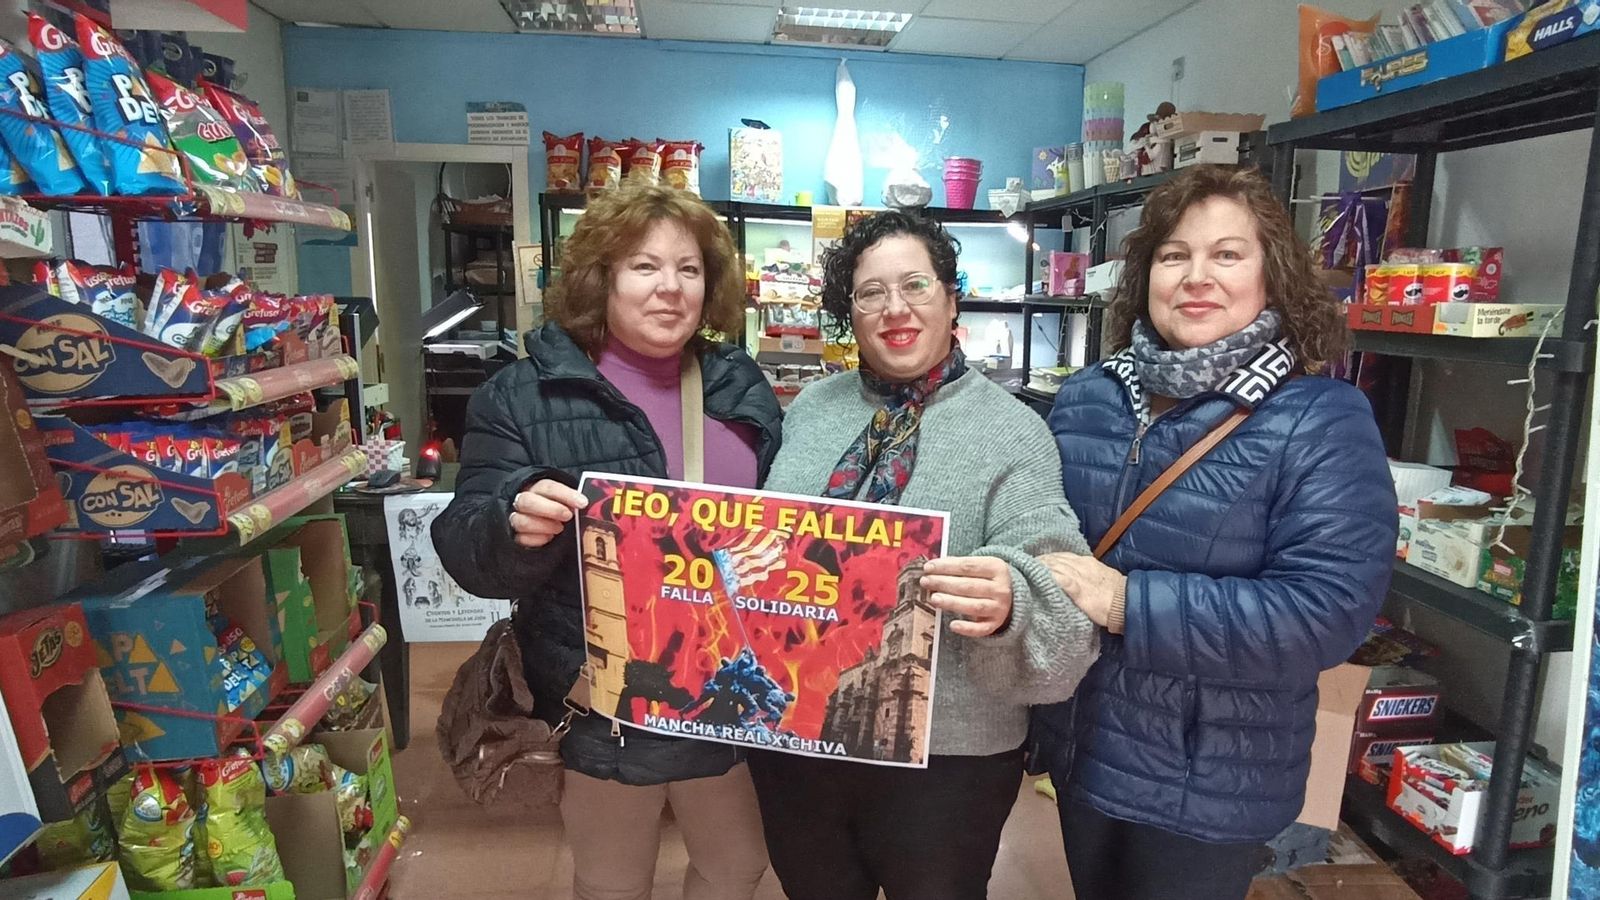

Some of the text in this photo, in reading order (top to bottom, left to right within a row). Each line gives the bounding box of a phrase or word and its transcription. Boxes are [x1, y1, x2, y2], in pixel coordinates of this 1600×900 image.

[1534, 16, 1573, 42] HALLS
[82, 483, 160, 512] CON SAL
[691, 495, 765, 532] QUÉ
[777, 506, 904, 548] FALLA!
[663, 554, 714, 590] 20
[660, 586, 714, 605] FALLA
[785, 570, 839, 606] 25
[735, 595, 839, 622] SOLIDARIA
[1372, 697, 1434, 717] SNICKERS
[643, 713, 716, 736] MANCHA
[722, 725, 767, 744] REAL
[788, 736, 848, 756] CHIVA
[1513, 802, 1550, 823] eno
